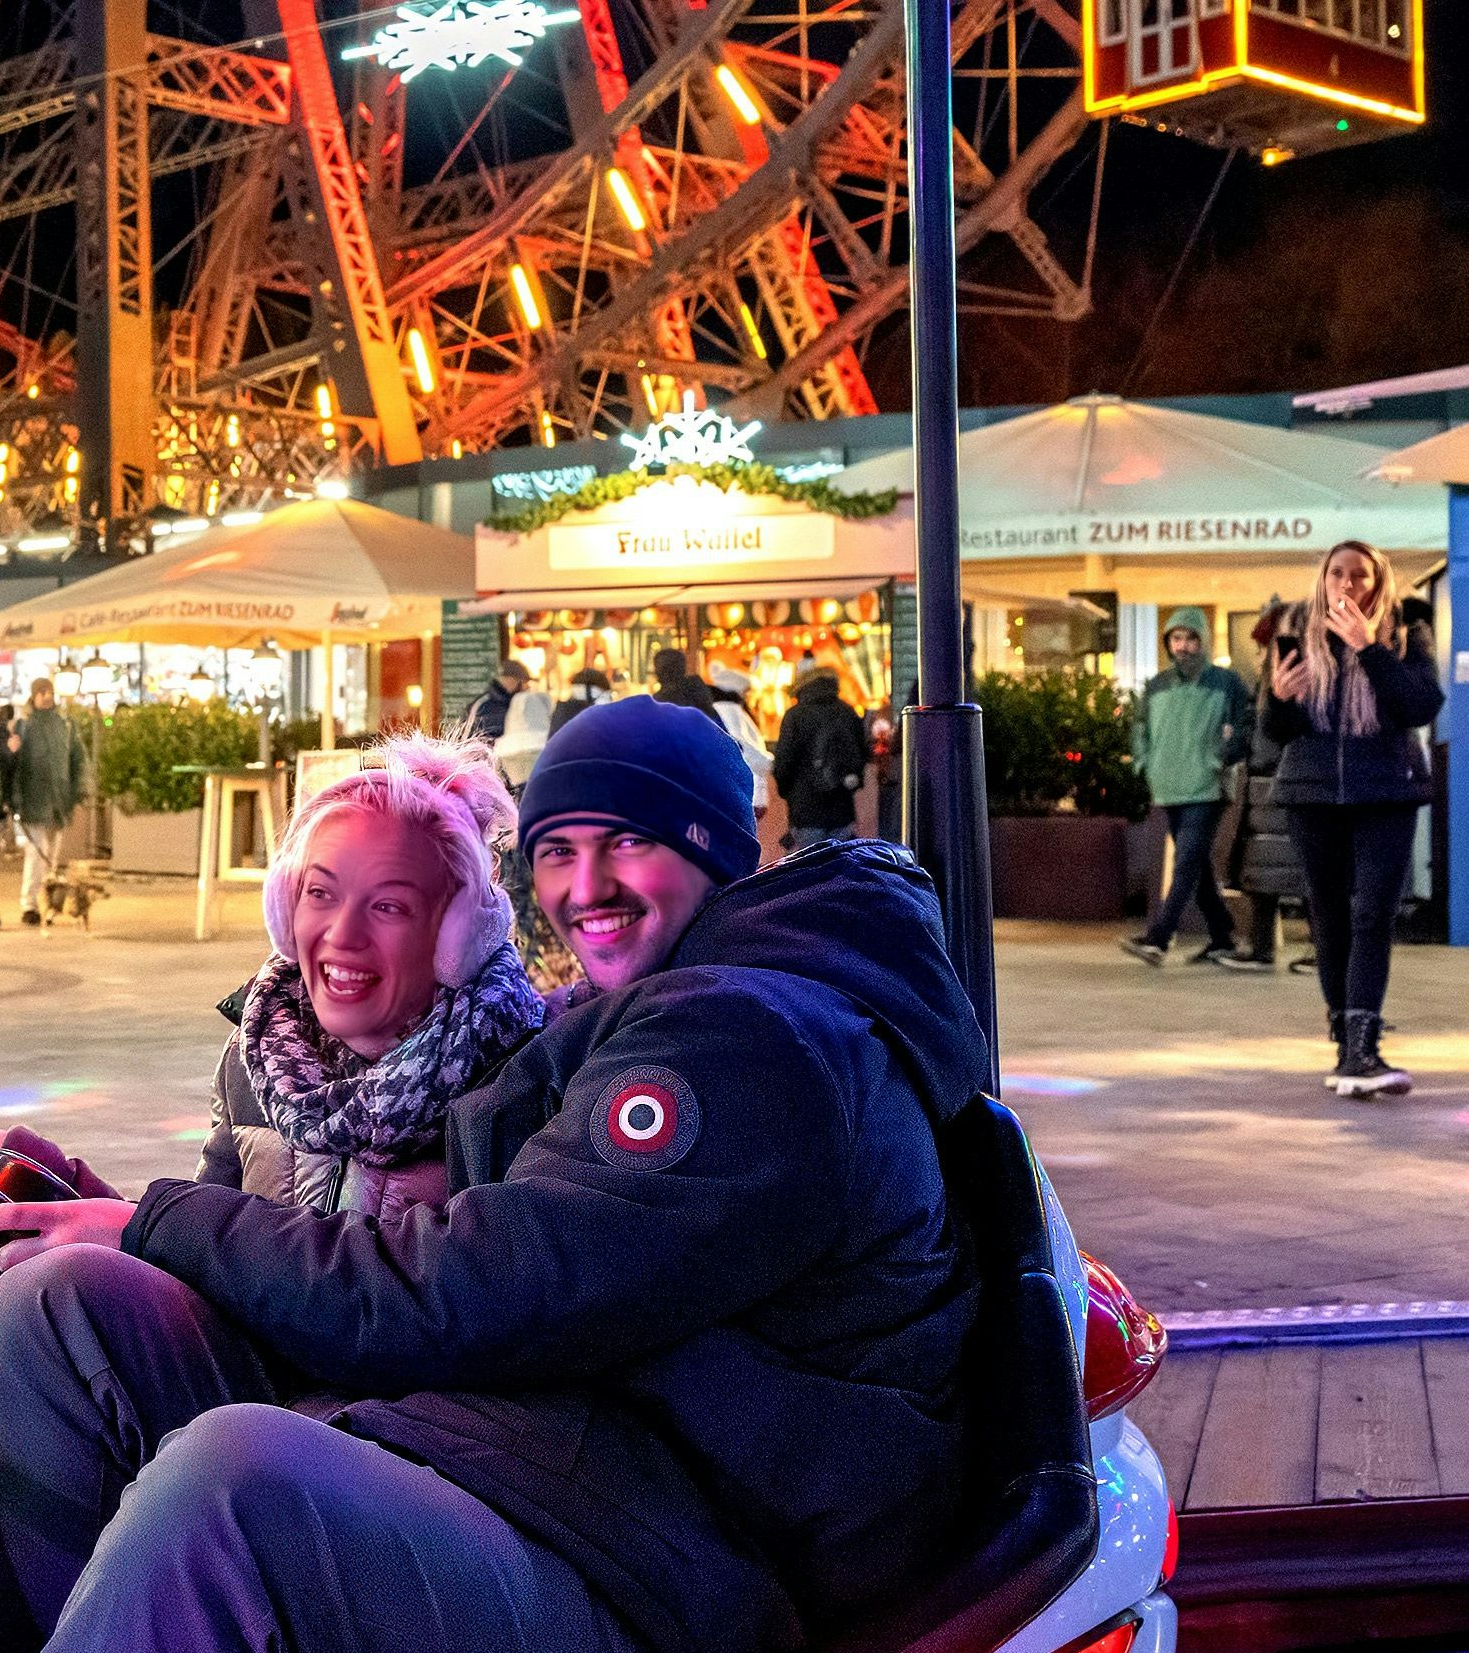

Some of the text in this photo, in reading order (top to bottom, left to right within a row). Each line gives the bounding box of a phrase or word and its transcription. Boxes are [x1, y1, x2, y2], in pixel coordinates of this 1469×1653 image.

[1089, 521, 1150, 543] ZUM
[1158, 517, 1312, 542] RIESENRAD
[617, 531, 671, 554] Frau
[179, 601, 213, 618] ZUM
[215, 602, 296, 621] RIESENRAD
